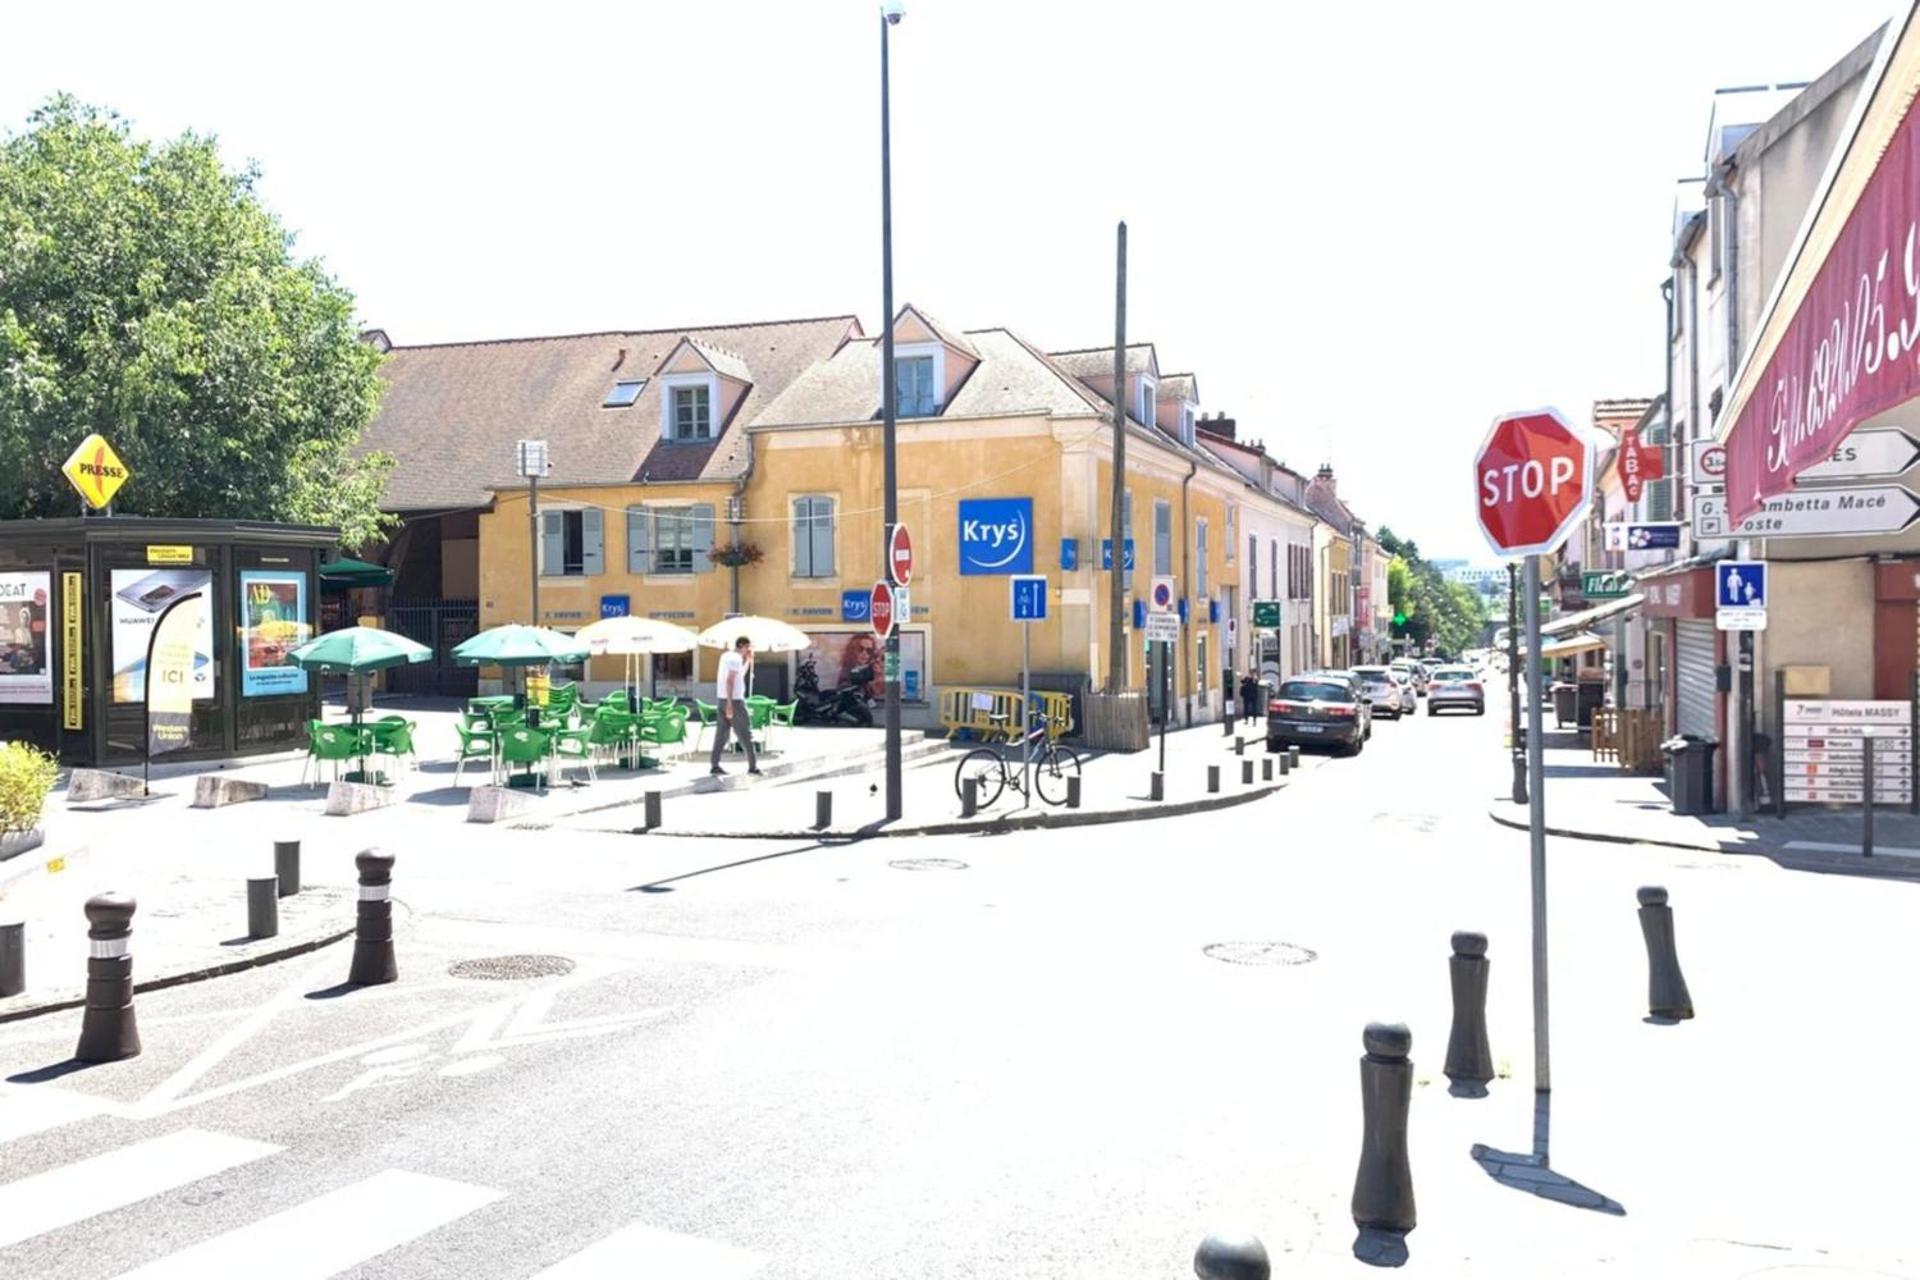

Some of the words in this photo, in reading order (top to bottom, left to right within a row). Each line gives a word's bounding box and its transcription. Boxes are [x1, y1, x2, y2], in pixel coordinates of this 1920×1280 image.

[79, 462, 124, 478] PRESSE
[1625, 436, 1640, 496] TABAC
[1483, 456, 1575, 507] STOP
[1838, 496, 1886, 509] Macé
[1739, 517, 1783, 532] oste
[963, 519, 1020, 549] Krys
[602, 603, 625, 616] Krys
[844, 600, 866, 614] Krys
[873, 602, 891, 617] STOP
[162, 669, 184, 683] ICI
[1865, 707, 1900, 717] MASSY
